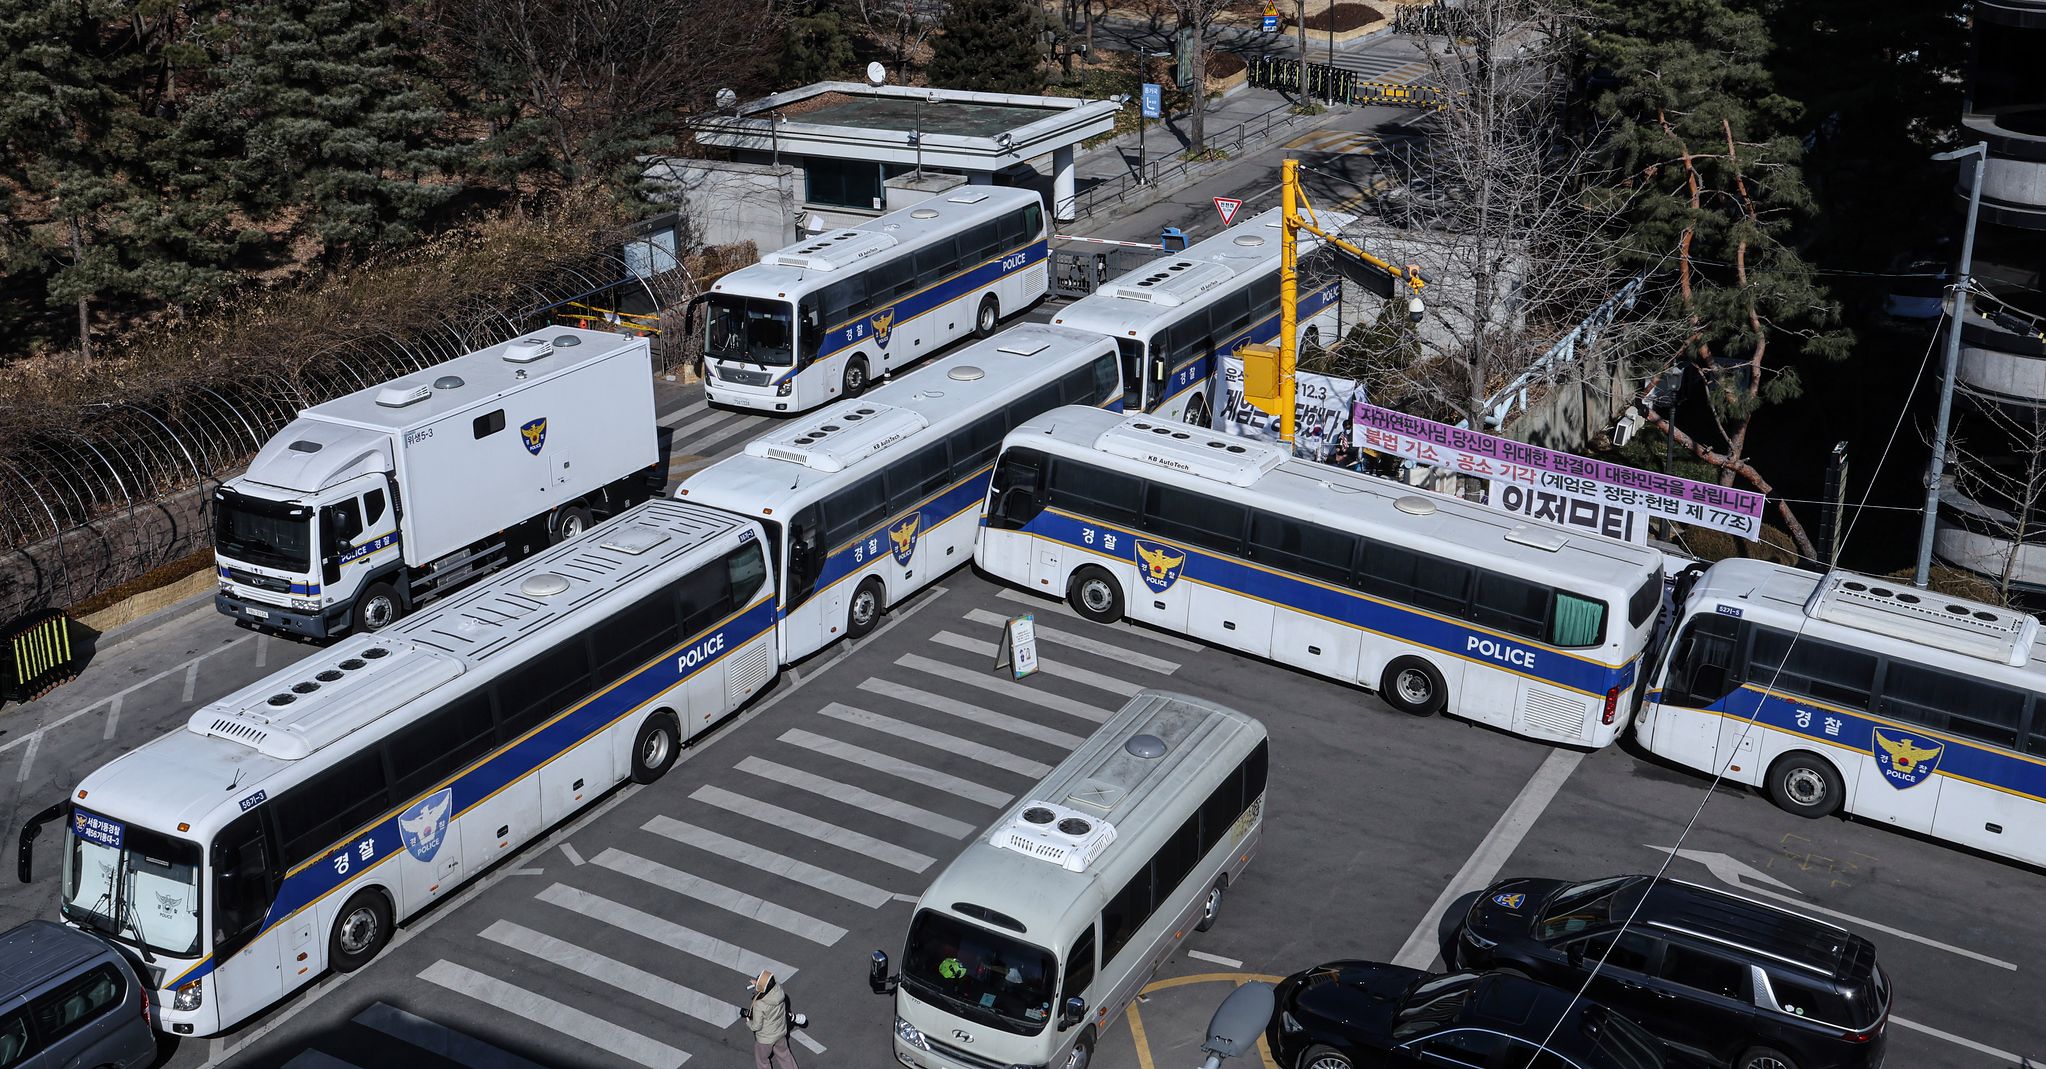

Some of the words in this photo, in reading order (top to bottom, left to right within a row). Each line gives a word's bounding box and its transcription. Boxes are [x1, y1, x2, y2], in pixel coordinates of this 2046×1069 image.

[1002, 253, 1026, 272] POLICE
[1322, 285, 1340, 304] POLIC
[1301, 383, 1327, 400] 12.3
[872, 443, 880, 451] KB
[881, 434, 901, 447] AutoTech
[1159, 458, 1189, 471] AutoTech
[1365, 428, 1399, 452] 불법
[1405, 437, 1440, 463] 기소
[1456, 452, 1493, 476] 공소
[1500, 463, 1537, 486] 기각
[1541, 471, 1598, 497] (계엄은
[1686, 503, 1703, 521] 제
[1709, 508, 1753, 534] 77조)
[1502, 441, 1548, 468] 위대한
[1552, 453, 1599, 479] 판결이
[1605, 466, 1685, 497] 대한민국을
[1690, 484, 1757, 514] 살립니다
[1082, 527, 1095, 544] 경
[1103, 533, 1117, 551] 찰
[341, 546, 367, 562] POLICE
[898, 549, 912, 560] POLICE
[1146, 576, 1168, 587] POLICE
[678, 632, 724, 674] POLICE
[1467, 635, 1536, 669] POLICE
[1794, 709, 1812, 728] 경
[1824, 716, 1843, 737] 찰
[1879, 754, 1889, 764] 경
[1886, 769, 1916, 783] POLICE
[241, 792, 264, 809] 56기-3
[87, 817, 121, 836] 서울기동경찰
[85, 827, 120, 846] 제56기동대-3
[334, 852, 350, 875] 경
[358, 838, 375, 861] 찰
[417, 838, 440, 856] POLICE
